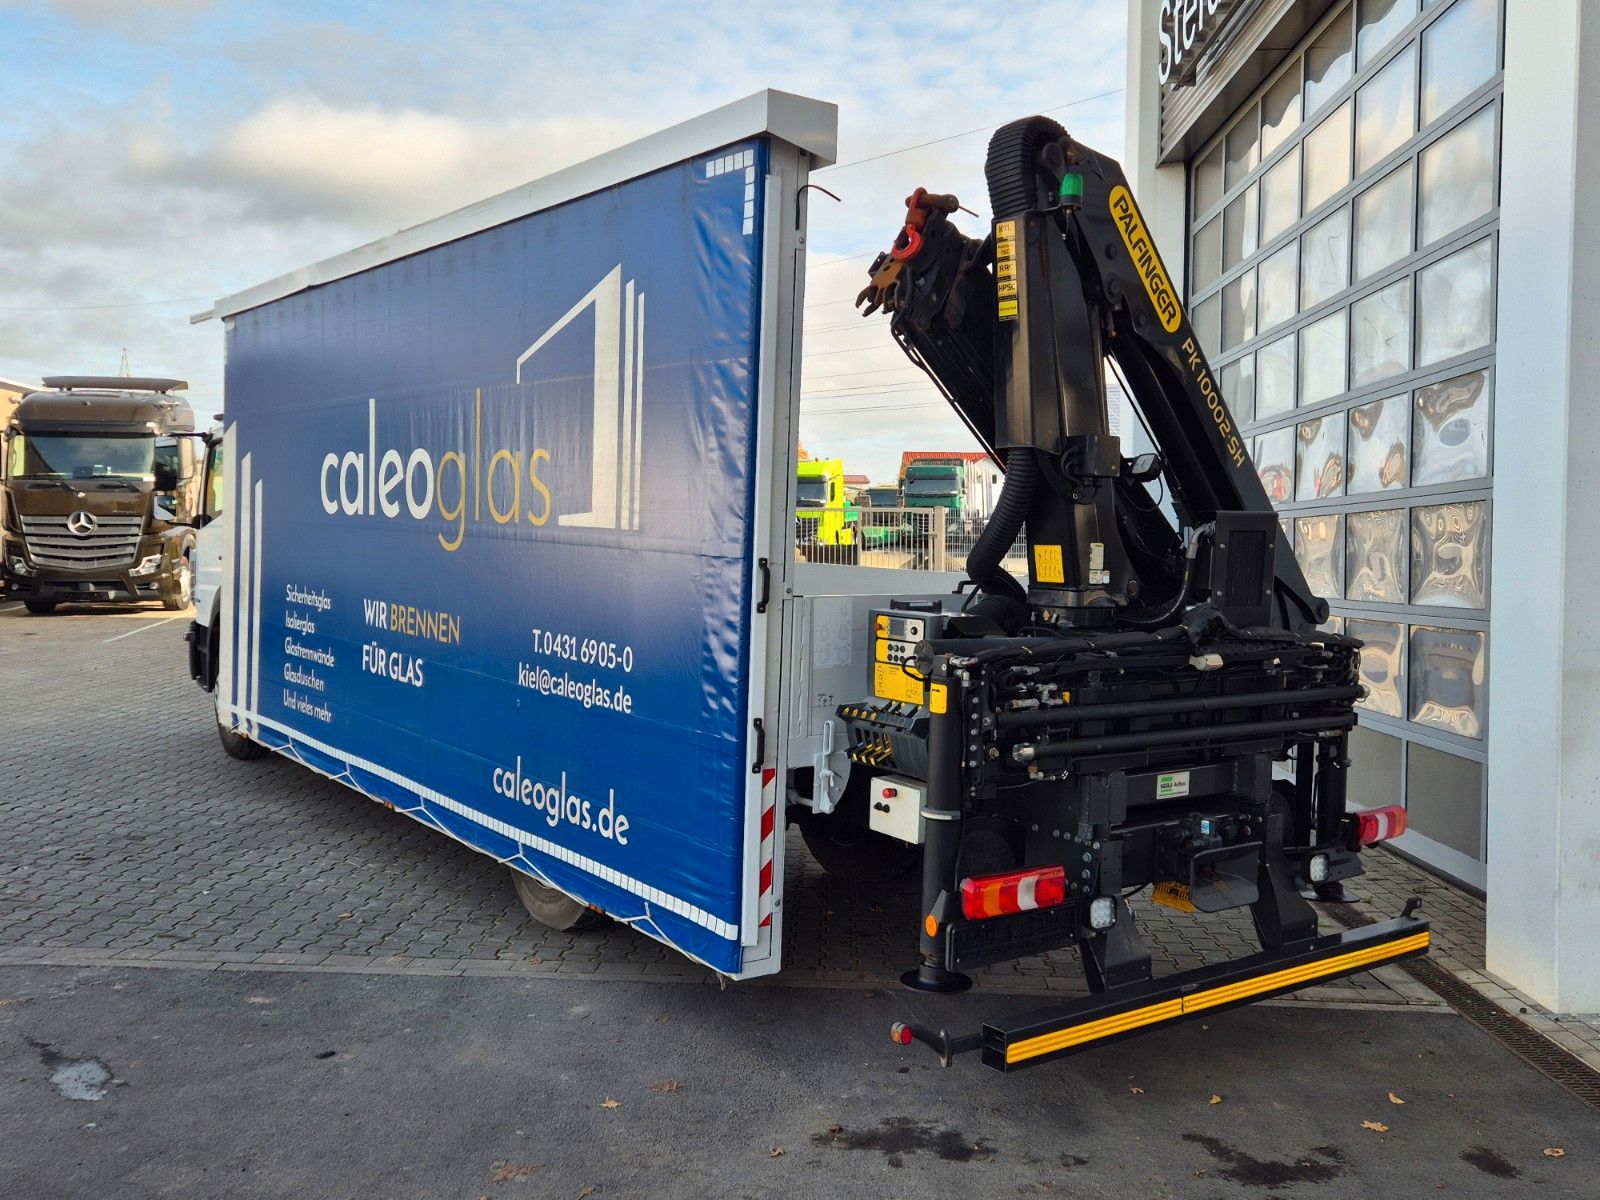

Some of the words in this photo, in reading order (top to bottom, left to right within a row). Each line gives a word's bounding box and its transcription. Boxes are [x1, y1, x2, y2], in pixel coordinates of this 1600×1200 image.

[1113, 193, 1177, 326] PALFINGER
[1182, 337, 1202, 372] PK
[320, 387, 552, 552] caleoglas
[286, 584, 332, 612] Sicherheitsglas
[285, 610, 315, 635] Isolierglas
[363, 598, 387, 630] WIR
[390, 603, 461, 647] BRENNEN
[284, 636, 336, 668] Glastrennwände
[362, 640, 387, 677] FÜR
[389, 651, 424, 687] GLAS
[580, 638, 633, 673] 6905-0
[284, 662, 325, 692] Glasduschen
[518, 661, 633, 714] kiel@caleoglas.de
[283, 688, 298, 710] Und
[296, 694, 314, 716] vieles
[313, 701, 332, 723] mehr
[492, 755, 630, 846] caleoglas.de
